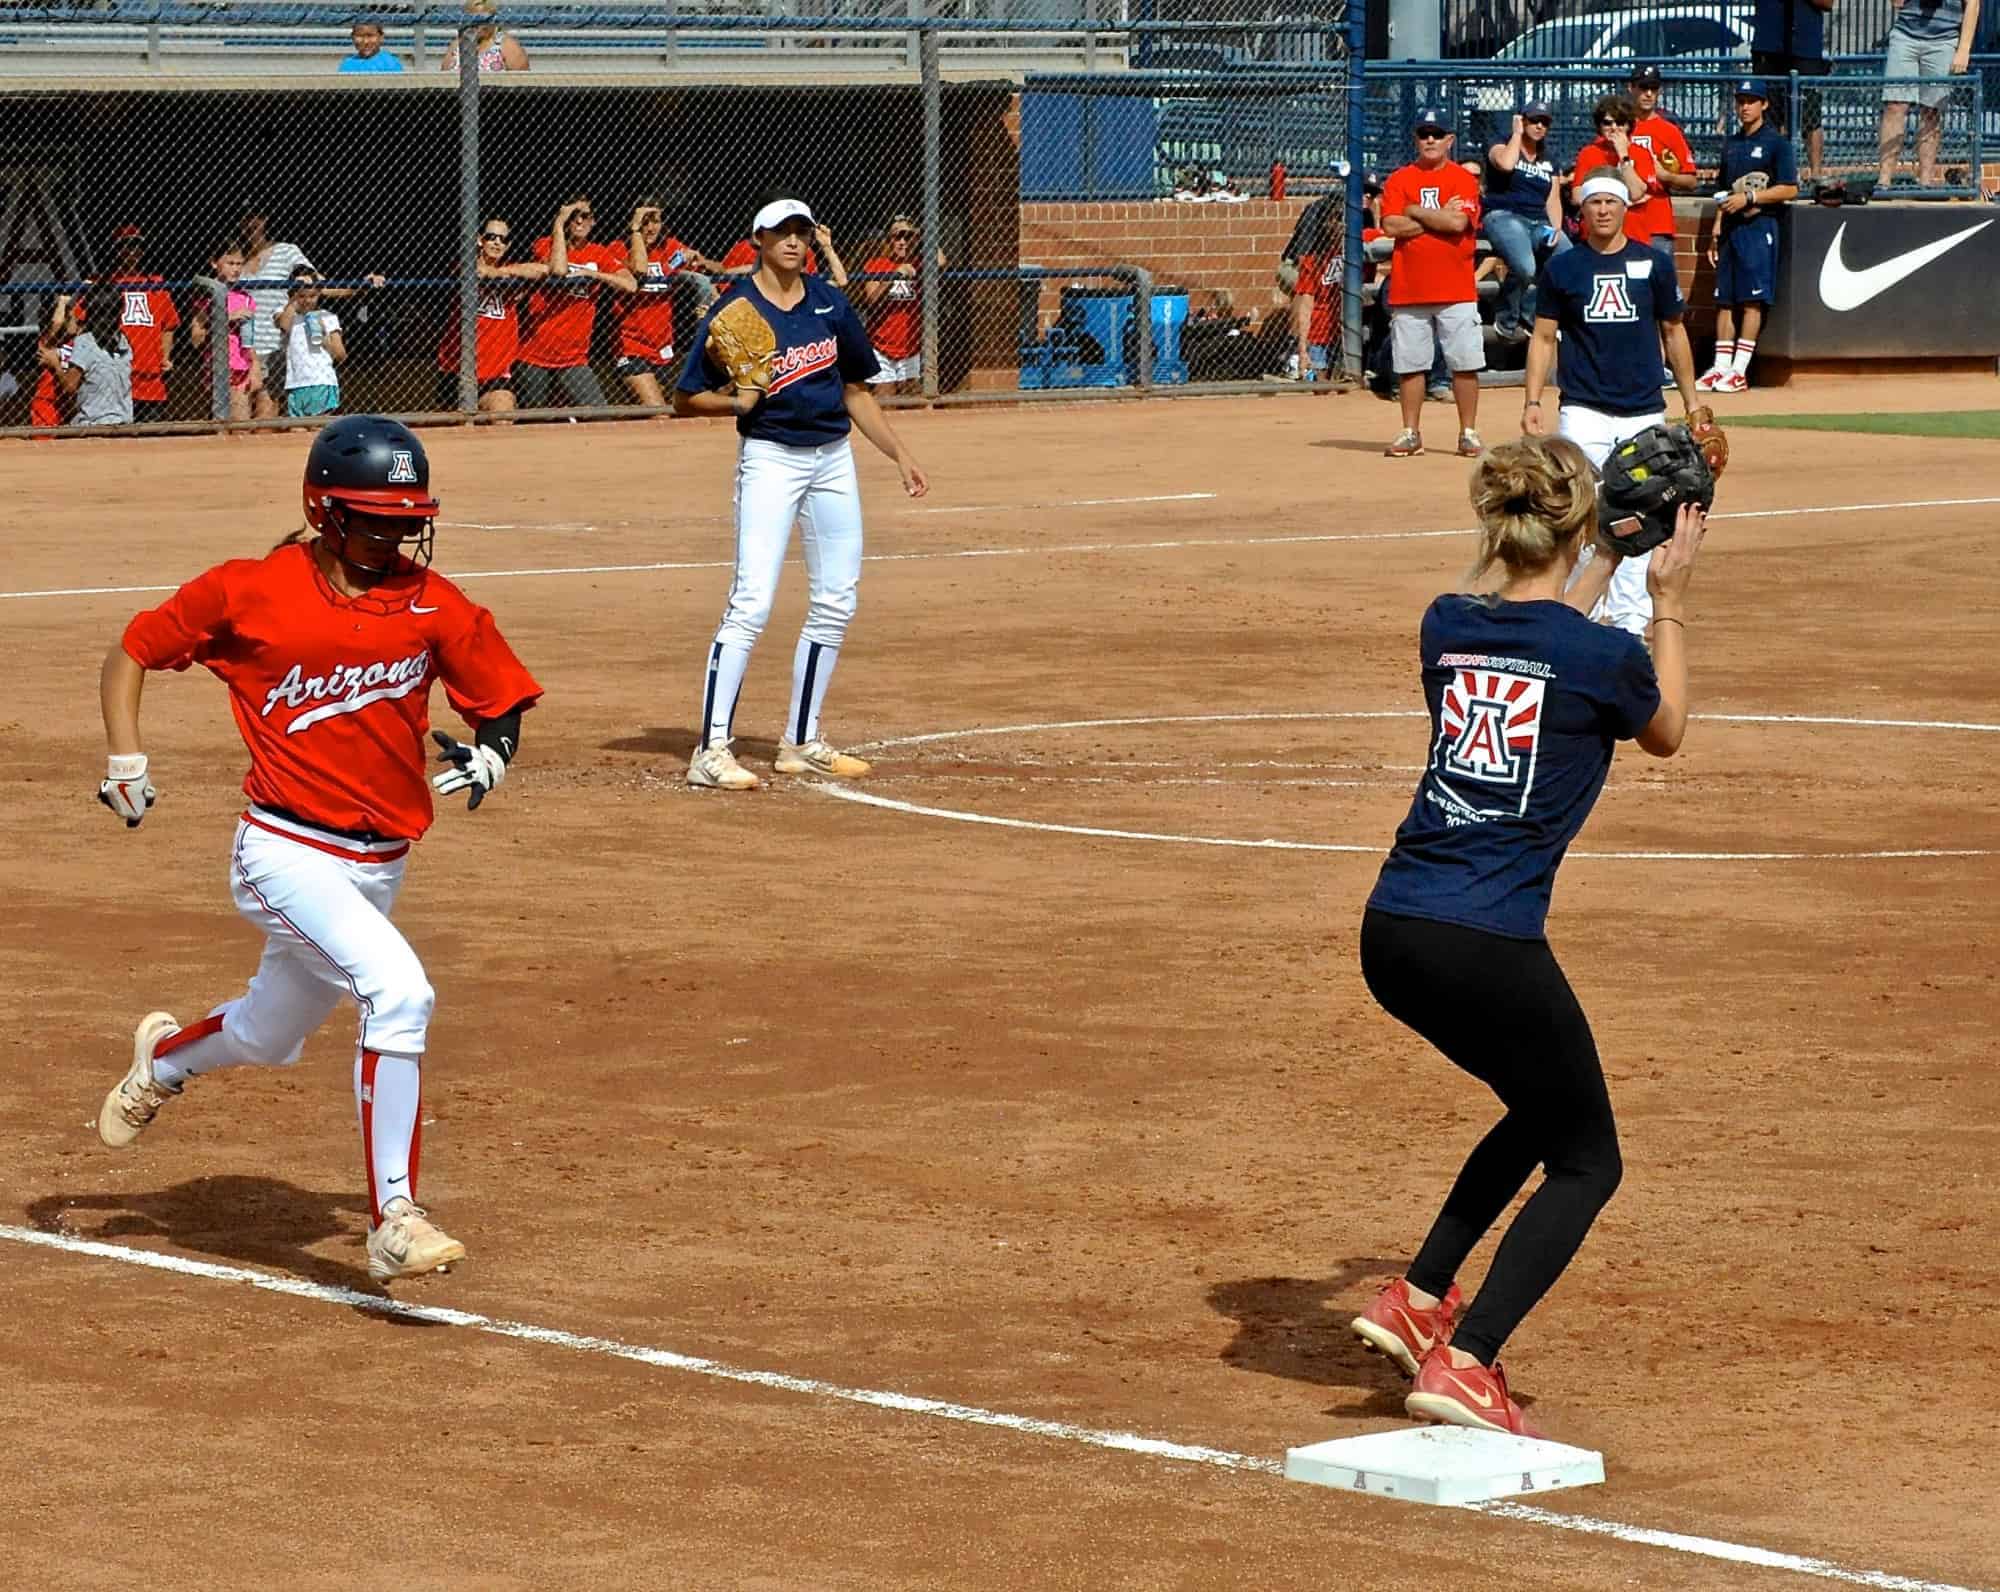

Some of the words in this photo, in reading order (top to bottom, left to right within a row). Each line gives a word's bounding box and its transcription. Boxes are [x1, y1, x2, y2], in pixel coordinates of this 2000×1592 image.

[1514, 160, 1551, 182] RIZONA
[122, 291, 154, 327] A
[1584, 273, 1635, 323] A
[771, 336, 838, 377] rizon
[388, 450, 417, 482] A
[261, 650, 430, 716] Arizona
[1446, 698, 1521, 784] A
[1521, 1471, 1534, 1491] A
